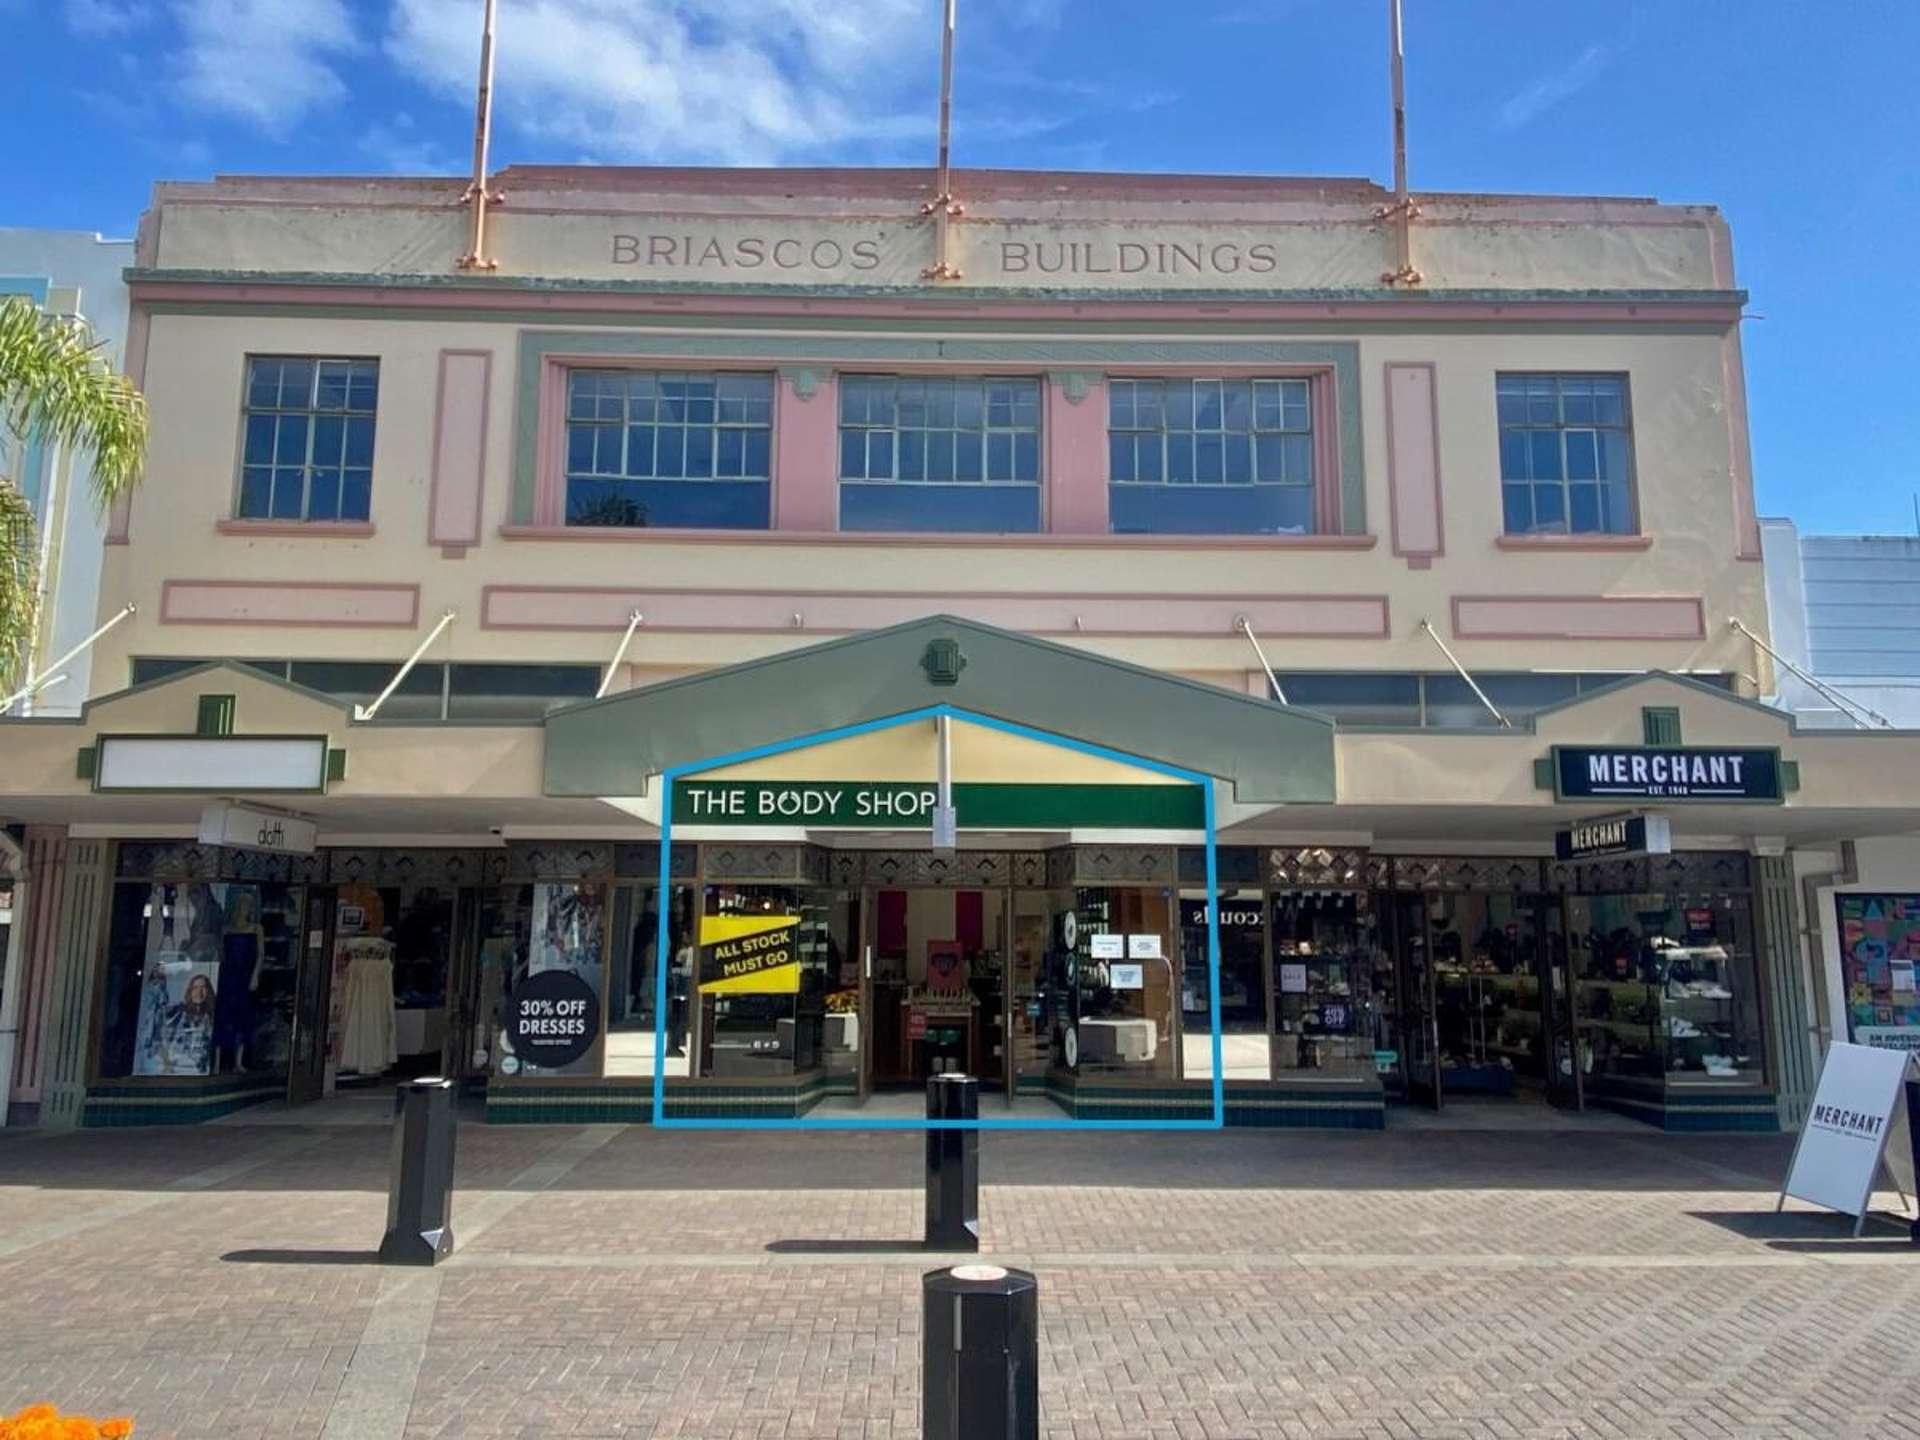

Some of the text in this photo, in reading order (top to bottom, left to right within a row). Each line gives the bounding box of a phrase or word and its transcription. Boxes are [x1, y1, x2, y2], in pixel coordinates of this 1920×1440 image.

[1000, 242, 1277, 274] BUILDINGS
[1588, 755, 1744, 784] MERCHANT
[687, 789, 936, 816] THE BODY SHOP
[1571, 819, 1627, 850] MERCHANT
[715, 929, 791, 961] ALL STOCK
[723, 950, 789, 977] MUST GO
[520, 1000, 587, 1016] 30% OFF
[519, 1019, 586, 1035] DRESSES
[1814, 1104, 1884, 1135] MERCHANT
